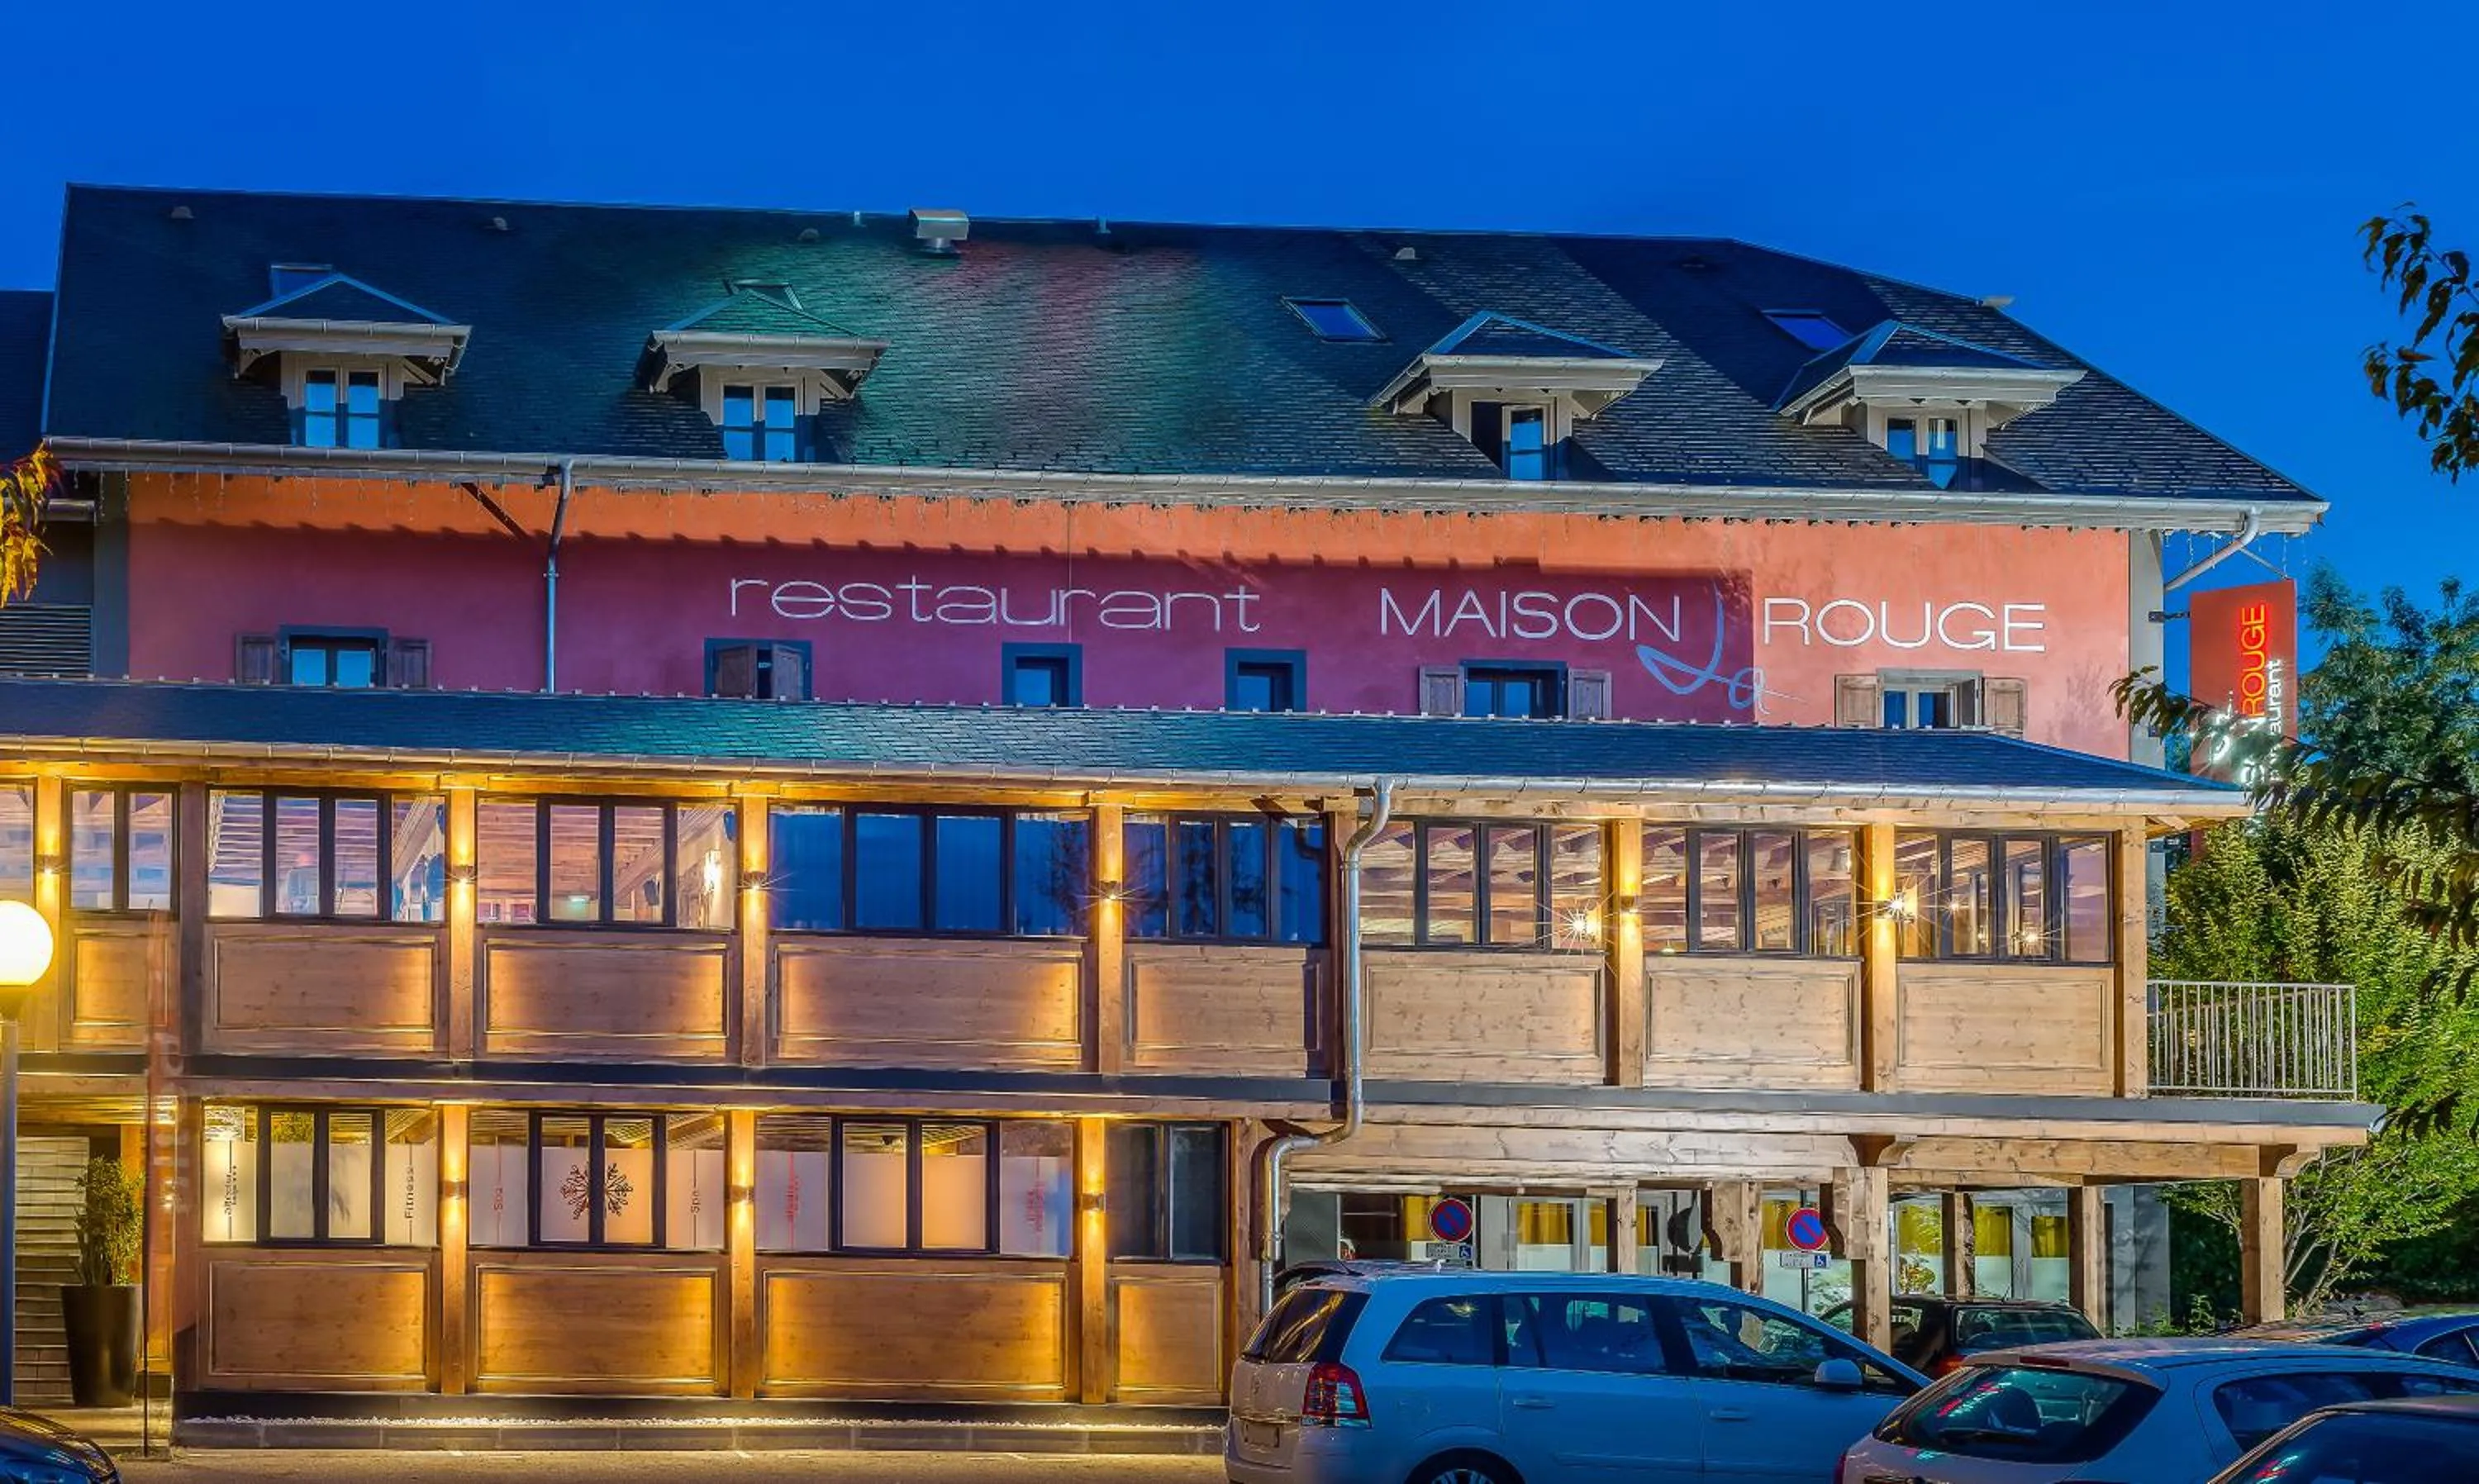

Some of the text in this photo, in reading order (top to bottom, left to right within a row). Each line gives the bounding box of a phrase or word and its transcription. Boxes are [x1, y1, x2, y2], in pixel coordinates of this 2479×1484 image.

[730, 574, 1261, 632] restaurant
[1381, 587, 2046, 652] MAISON ROUGE
[2241, 604, 2266, 718] ROUGE
[404, 1167, 414, 1220] Fitness
[493, 1187, 503, 1211] Spa
